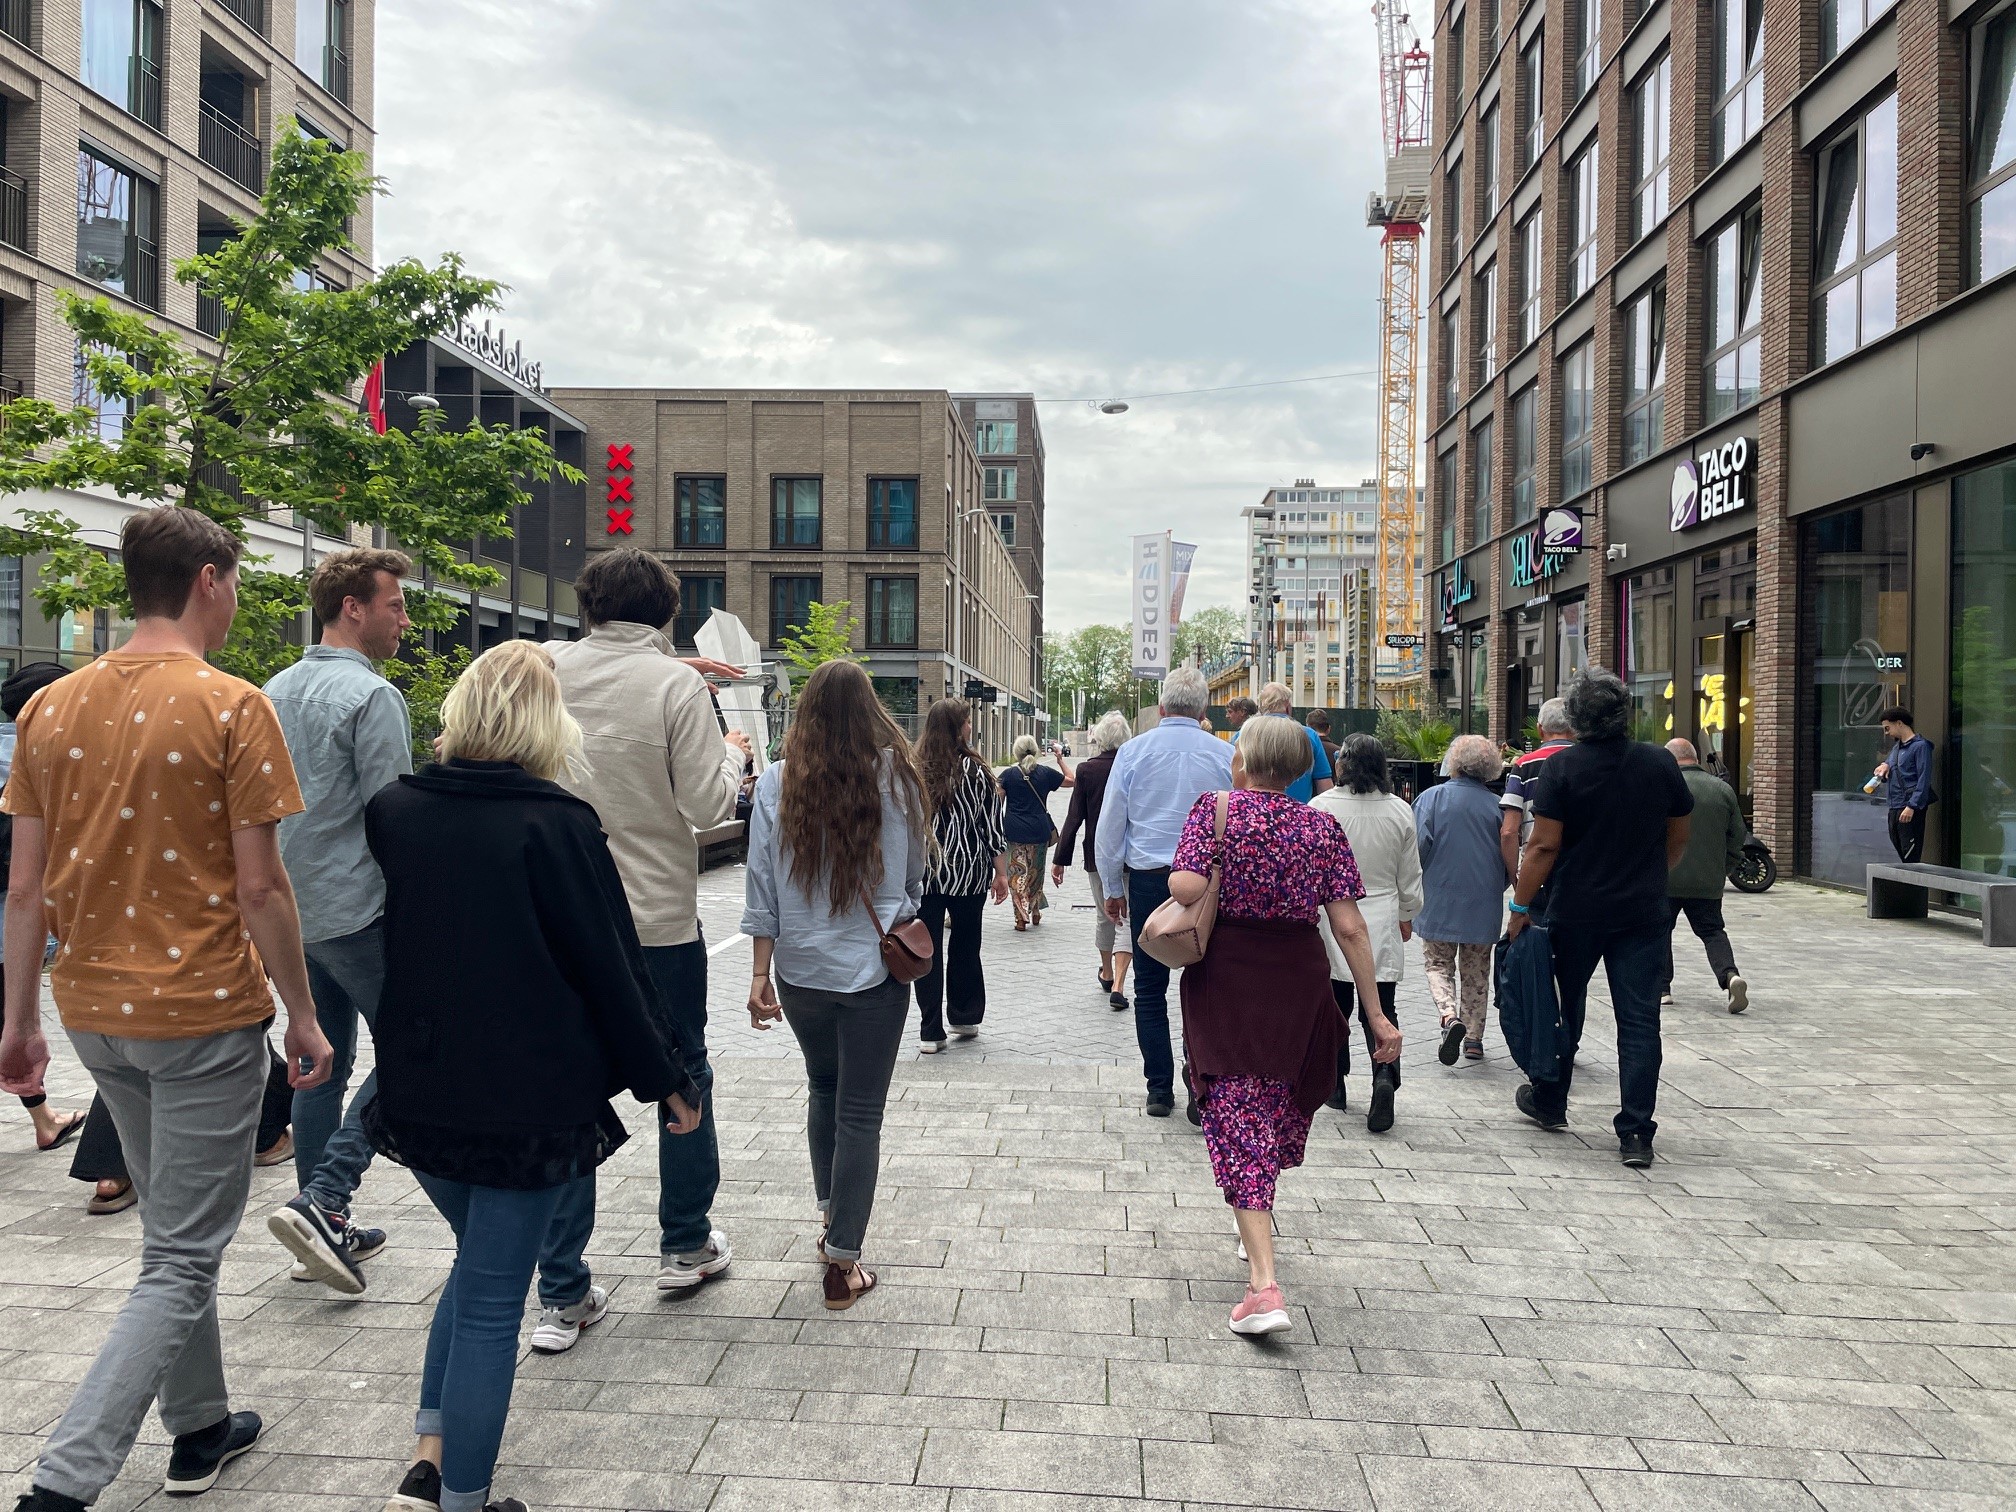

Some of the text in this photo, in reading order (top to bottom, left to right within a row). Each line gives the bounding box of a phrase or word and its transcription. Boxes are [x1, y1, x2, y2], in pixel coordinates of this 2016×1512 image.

[443, 309, 545, 393] Stadsloket
[1699, 436, 1747, 486] TACO
[1700, 475, 1745, 521] BELL
